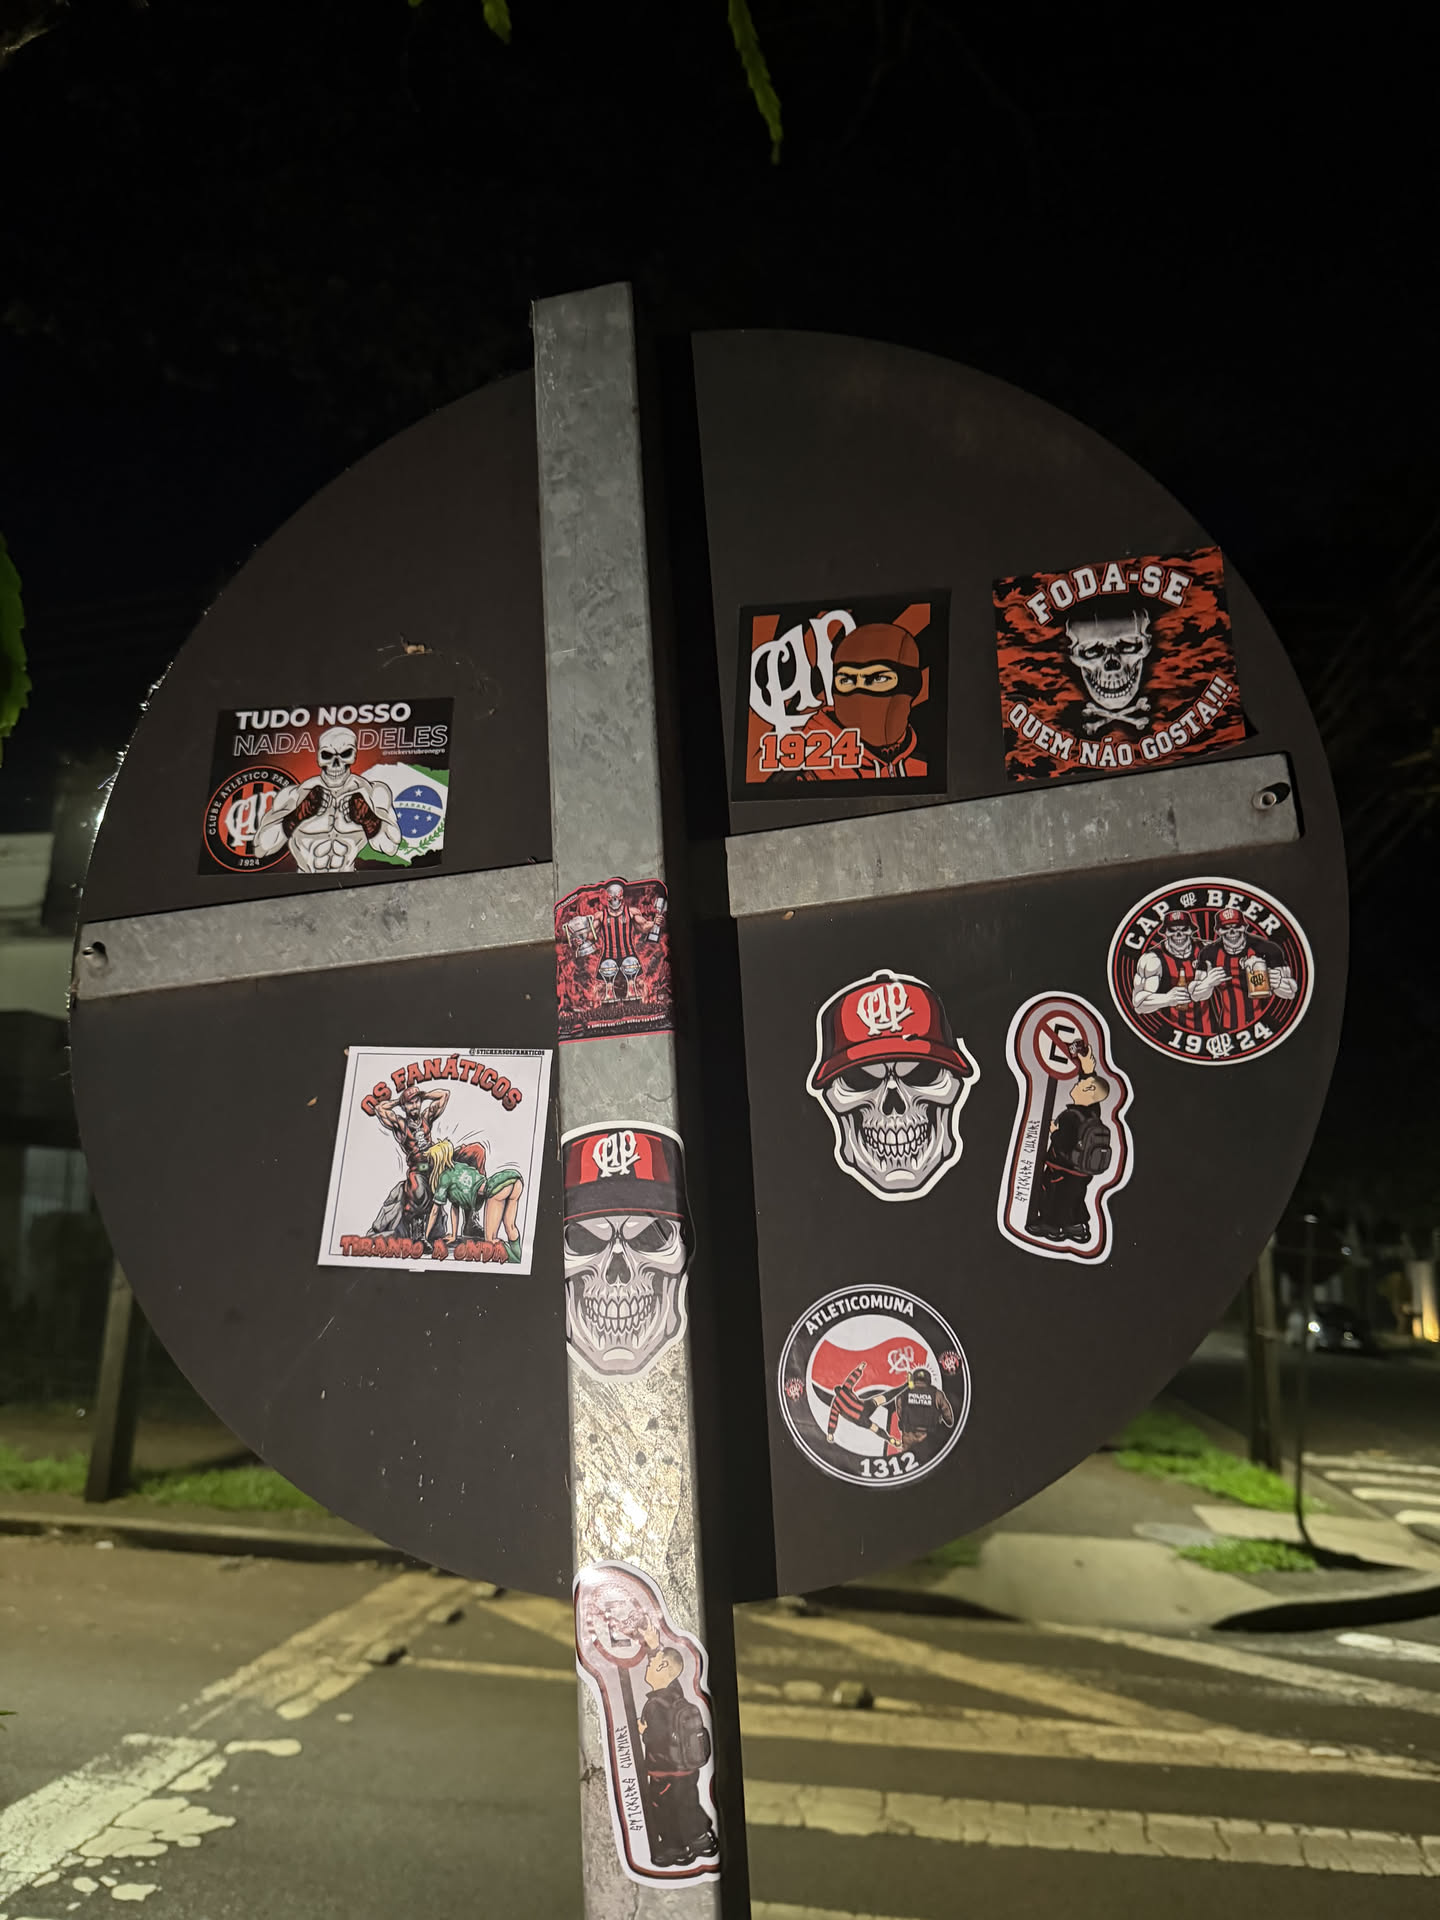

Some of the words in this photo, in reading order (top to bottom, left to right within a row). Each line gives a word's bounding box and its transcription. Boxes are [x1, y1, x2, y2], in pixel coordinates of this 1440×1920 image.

[1026, 562, 1191, 625] FODA-SE
[236, 709, 311, 730] TUDO
[317, 702, 412, 726] NOSSO
[1008, 703, 1075, 761] QUEM
[1079, 737, 1133, 767] NÃO
[1140, 675, 1234, 761] GOSTA!!!
[233, 732, 316, 756] NADA
[357, 725, 448, 749] DELES
[759, 728, 864, 772] 1924
[208, 801, 222, 836] CLUBE
[239, 858, 260, 867] 1924
[1124, 901, 1171, 950] CAP
[1205, 889, 1282, 936] BEER
[361, 1081, 392, 1117] OS
[390, 1053, 523, 1112] FANÁTICOS
[432, 1238, 449, 1262] A
[804, 1294, 915, 1336] ATLETICOMUNA
[859, 1451, 920, 1478] 1312
